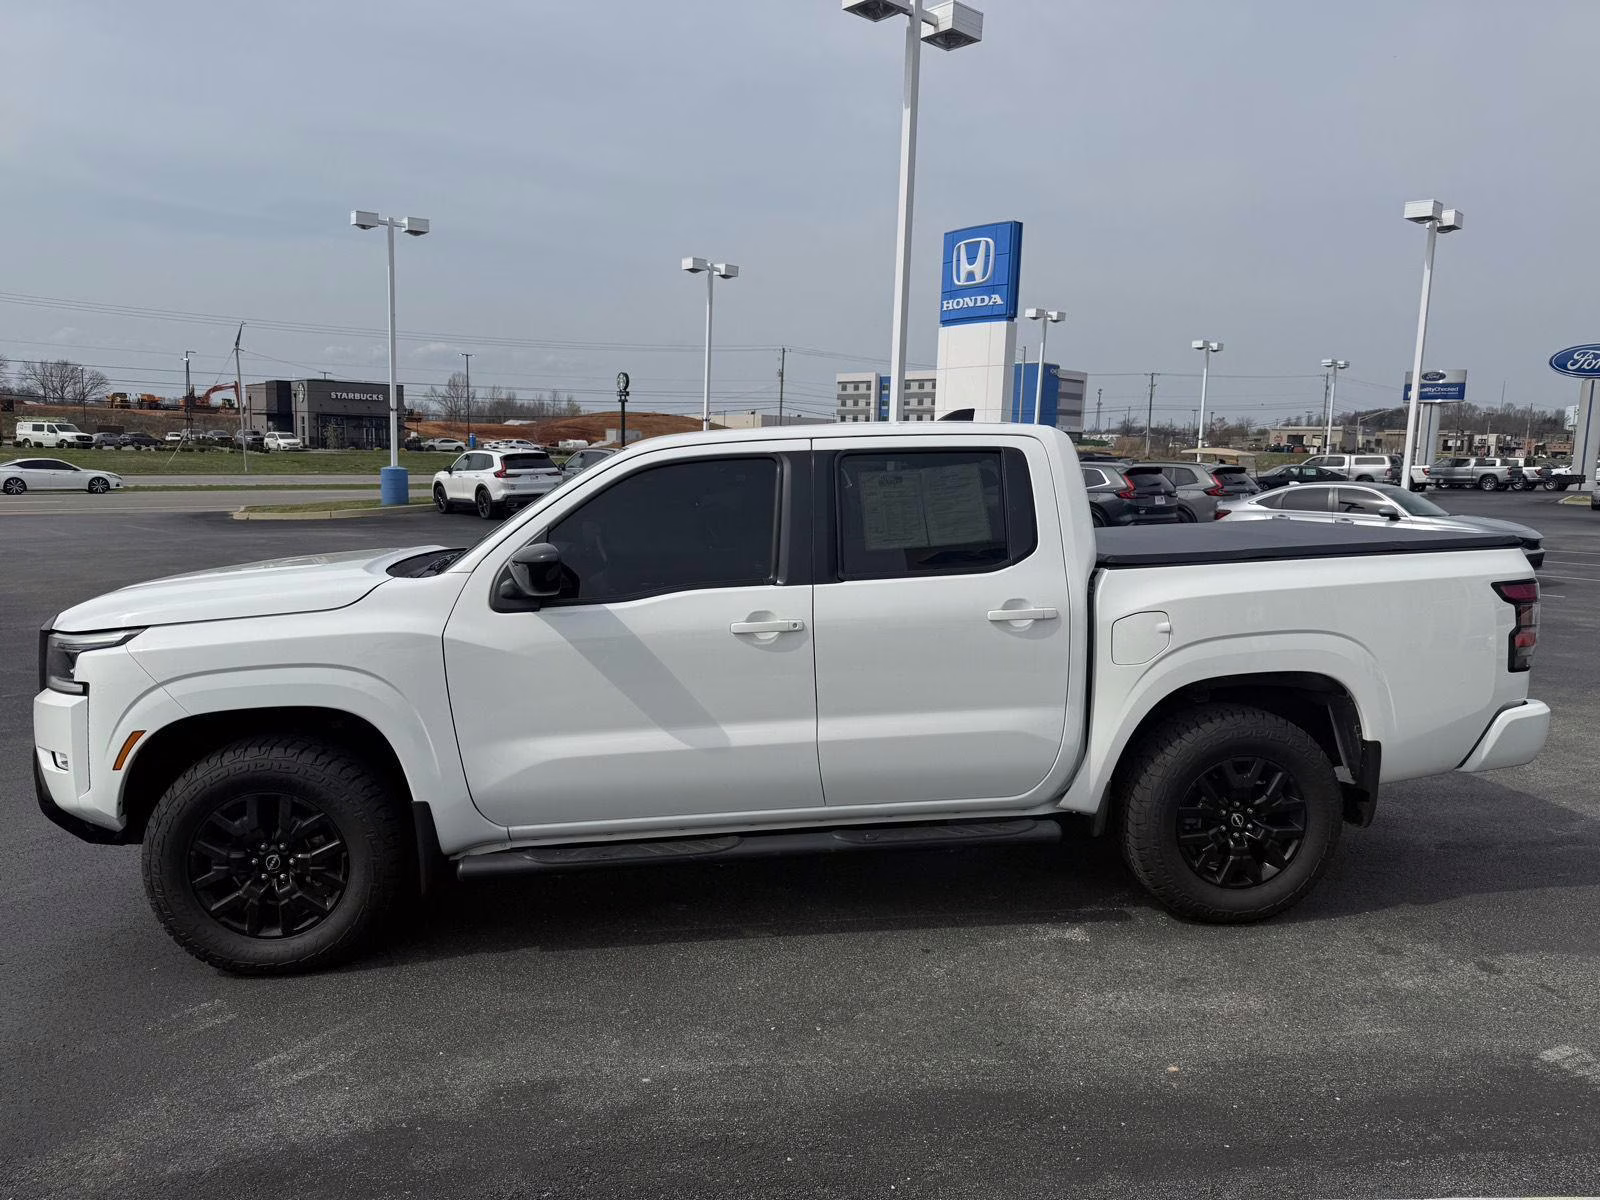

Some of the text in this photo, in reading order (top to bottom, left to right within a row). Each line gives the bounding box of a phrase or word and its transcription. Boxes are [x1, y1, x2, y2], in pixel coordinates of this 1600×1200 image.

[942, 294, 1004, 311] HONDA
[1567, 350, 1600, 370] For
[330, 391, 384, 401] STARBUCKS
